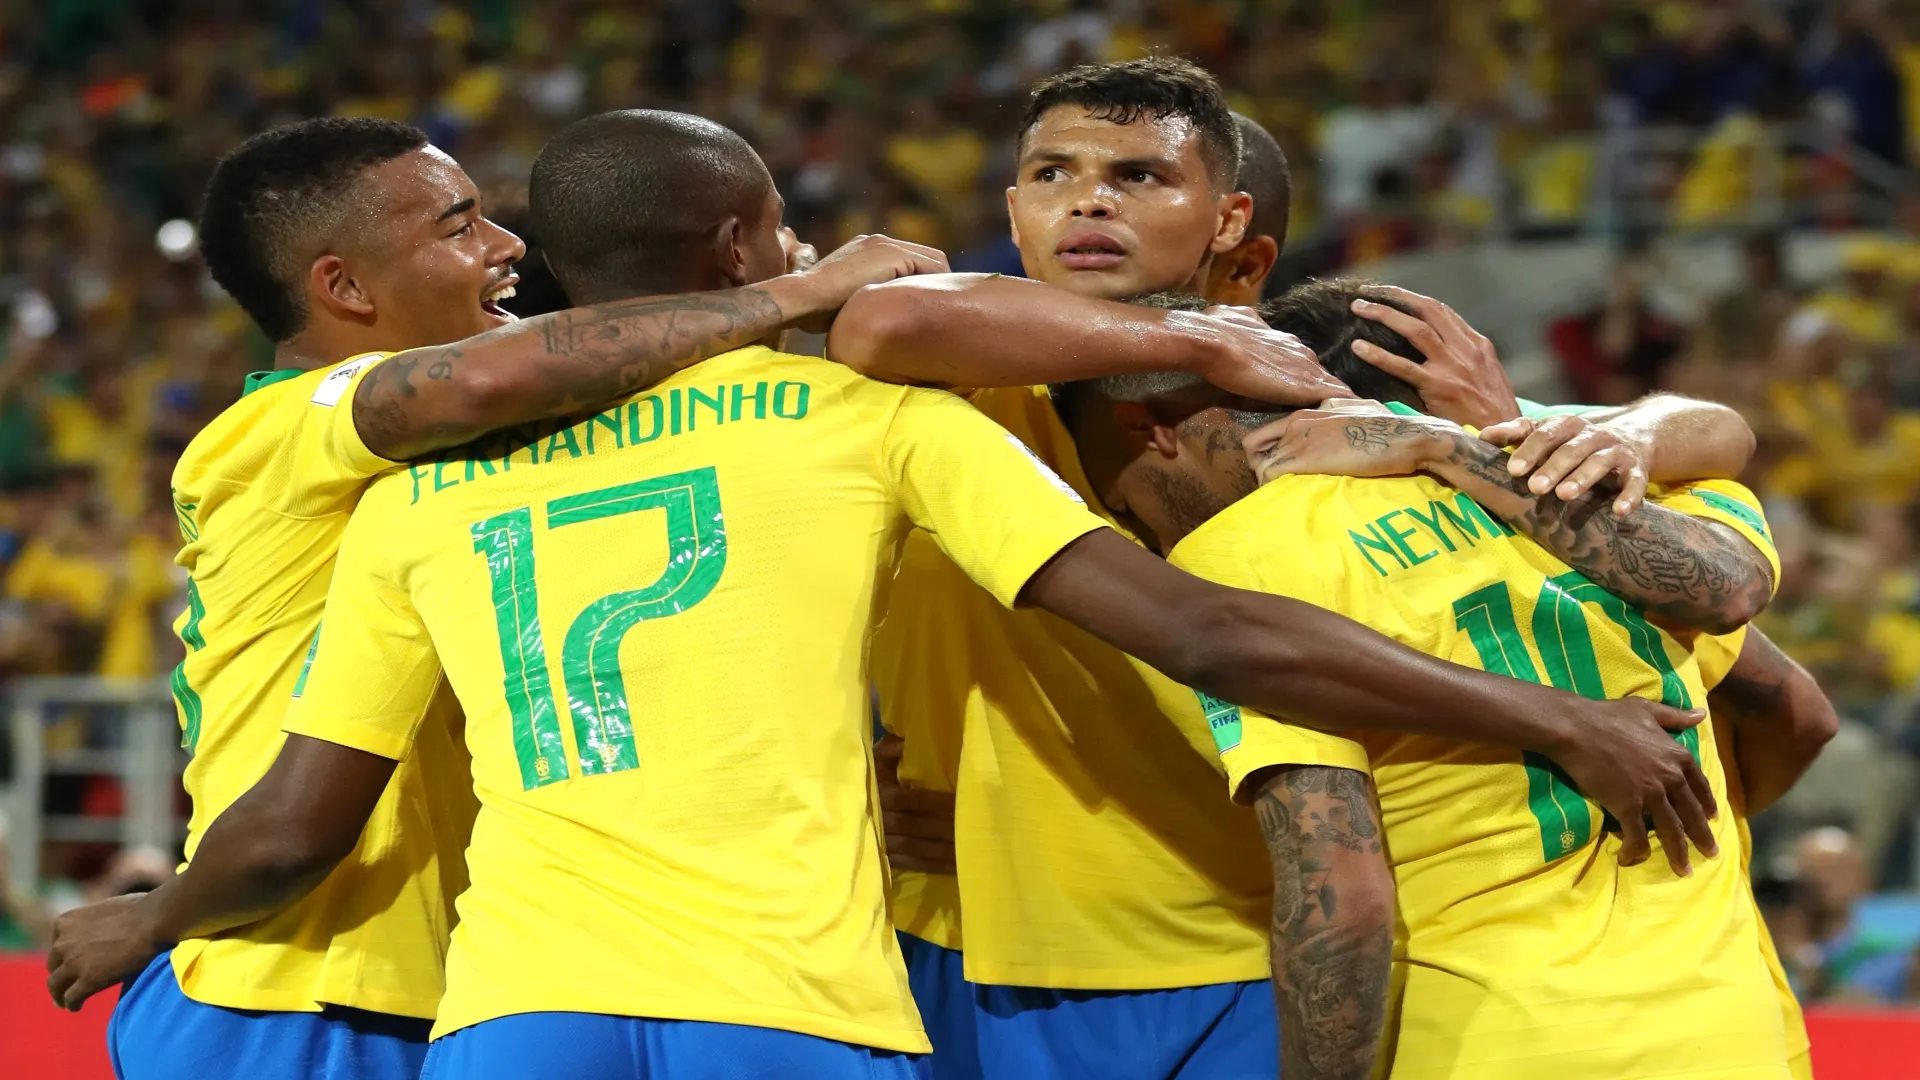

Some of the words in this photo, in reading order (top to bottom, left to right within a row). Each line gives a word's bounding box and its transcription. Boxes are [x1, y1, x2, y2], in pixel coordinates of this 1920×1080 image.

[409, 380, 811, 503] FERNANDINHO
[1347, 491, 1518, 577] NEYM
[470, 465, 728, 792] 17
[1211, 712, 1239, 729] FIFA
